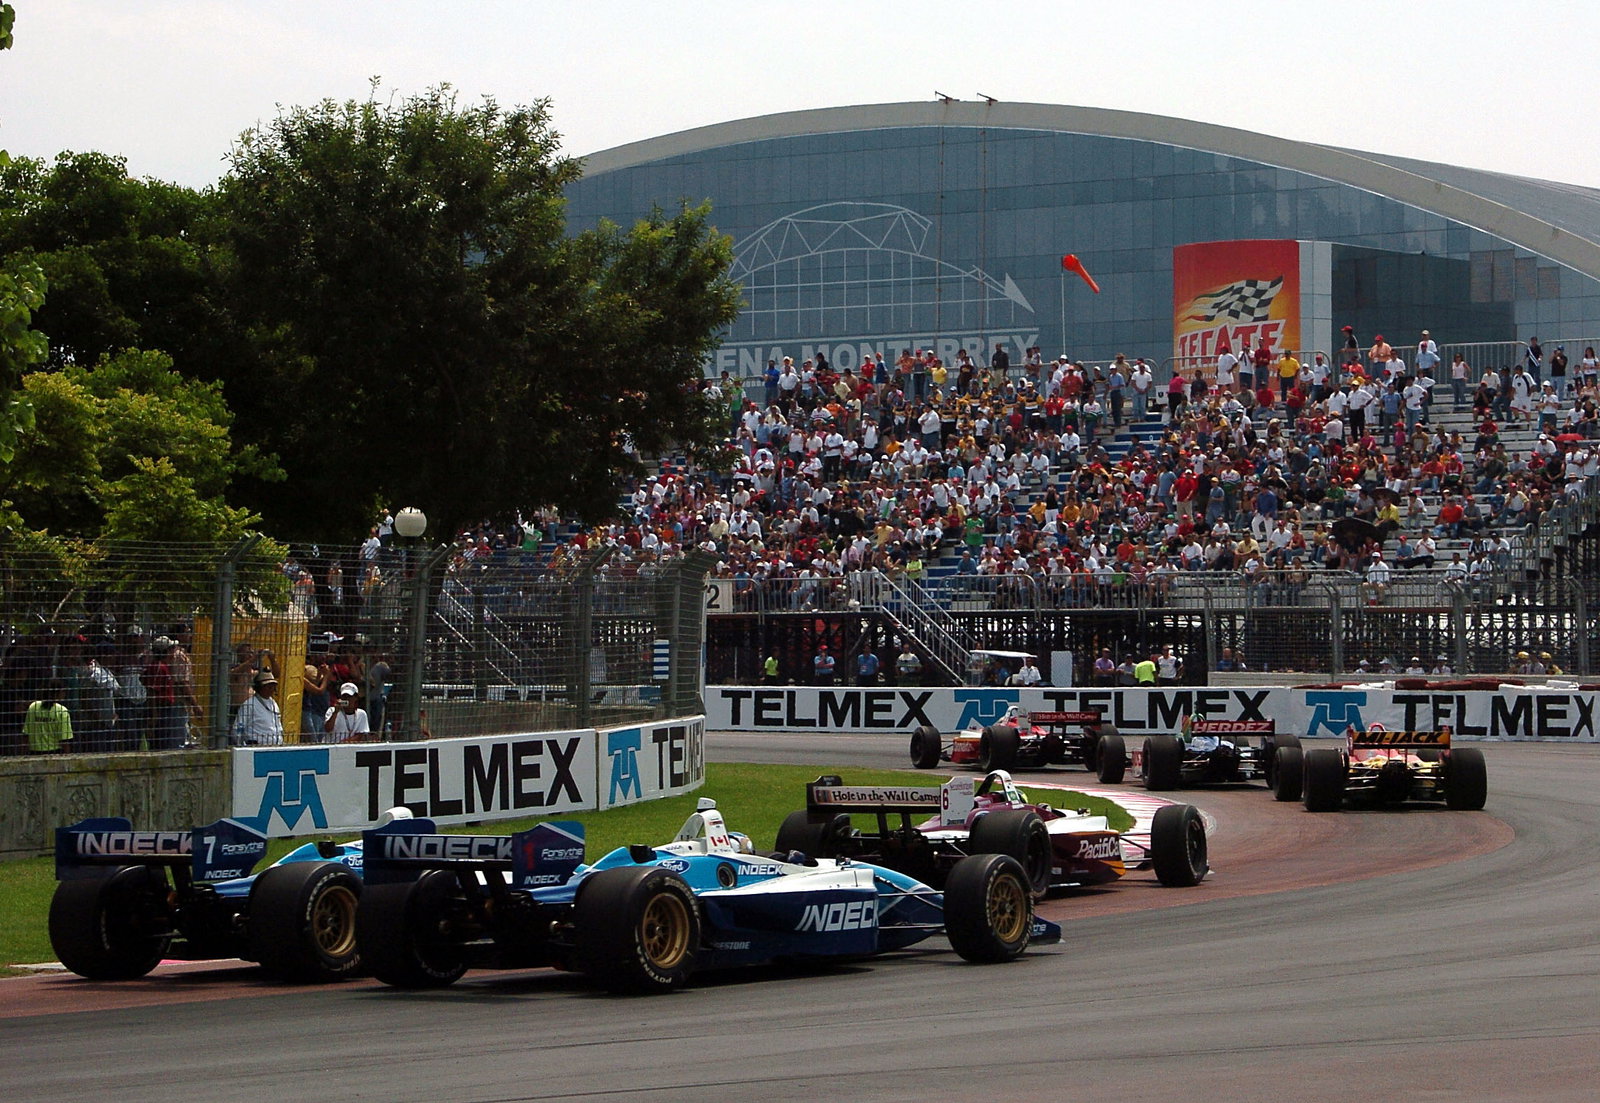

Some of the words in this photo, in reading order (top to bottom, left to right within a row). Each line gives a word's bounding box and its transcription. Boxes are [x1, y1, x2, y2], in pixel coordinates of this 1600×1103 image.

[1178, 321, 1282, 368] TECATE
[701, 346, 786, 378] ENA
[720, 689, 934, 729] TELMEX
[1043, 690, 1271, 730] TELMEX
[1392, 694, 1595, 737] TELMEX
[1192, 722, 1271, 733] HERDEZ
[355, 737, 583, 822] TELMEX
[832, 791, 855, 801] Hole
[856, 790, 867, 801] in
[868, 790, 884, 801] the
[884, 790, 908, 801] Wall
[943, 788, 949, 810] 6
[77, 832, 192, 855] INDECK
[203, 836, 216, 864] 7
[221, 841, 264, 852] Forsythe
[384, 836, 513, 859] INDECK
[541, 847, 583, 858] Forsythe
[1072, 836, 1119, 859] PacifiCa
[524, 842, 535, 870] 1
[205, 869, 242, 878] INDECK
[524, 874, 561, 885] INDECK
[737, 864, 784, 876] INDECK
[794, 899, 879, 932] INDECK
